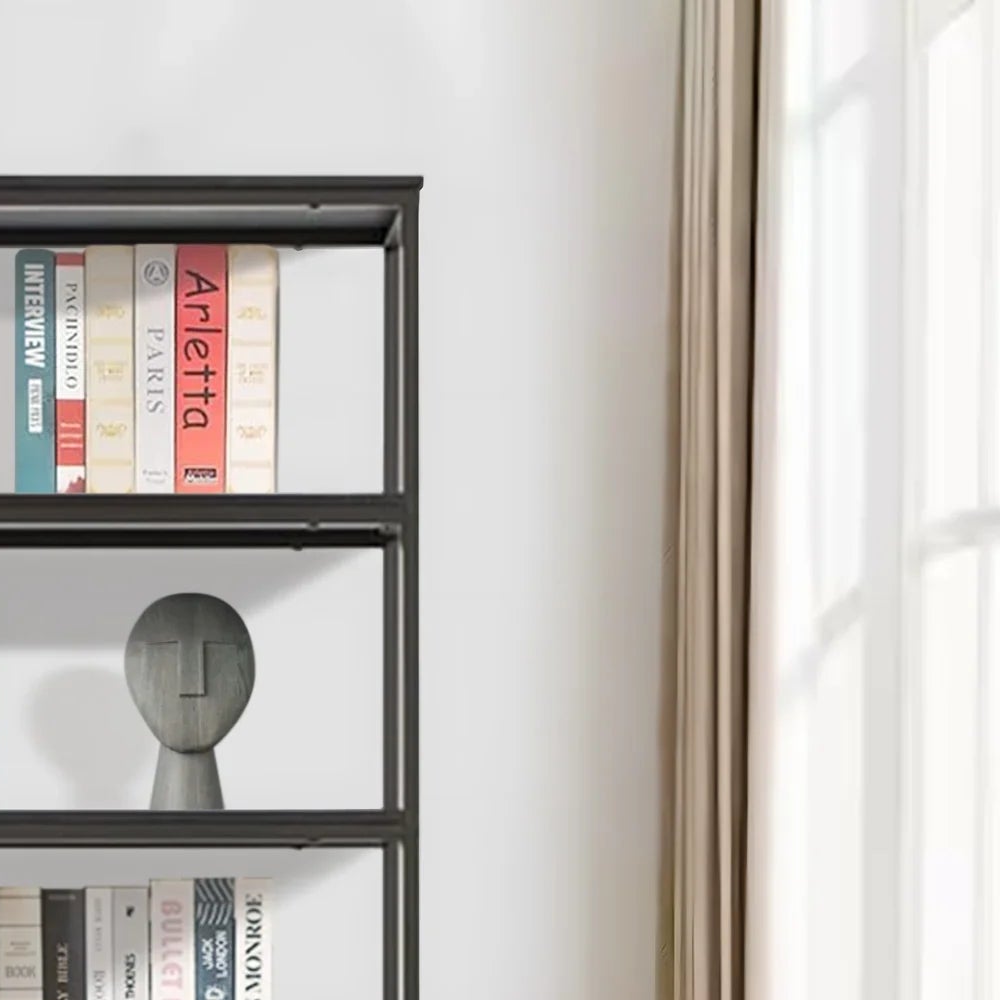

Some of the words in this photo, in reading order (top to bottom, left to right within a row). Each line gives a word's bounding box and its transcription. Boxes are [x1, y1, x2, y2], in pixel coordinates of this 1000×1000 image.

[24, 263, 46, 368] INTERVIEW
[146, 328, 165, 413] PARIS
[183, 270, 223, 429] Arletta
[5, 966, 37, 979] BOOK
[57, 943, 70, 983] BIBLE
[202, 938, 214, 970] JACK
[216, 930, 228, 978] LONDON
[244, 893, 263, 993] MONROE
